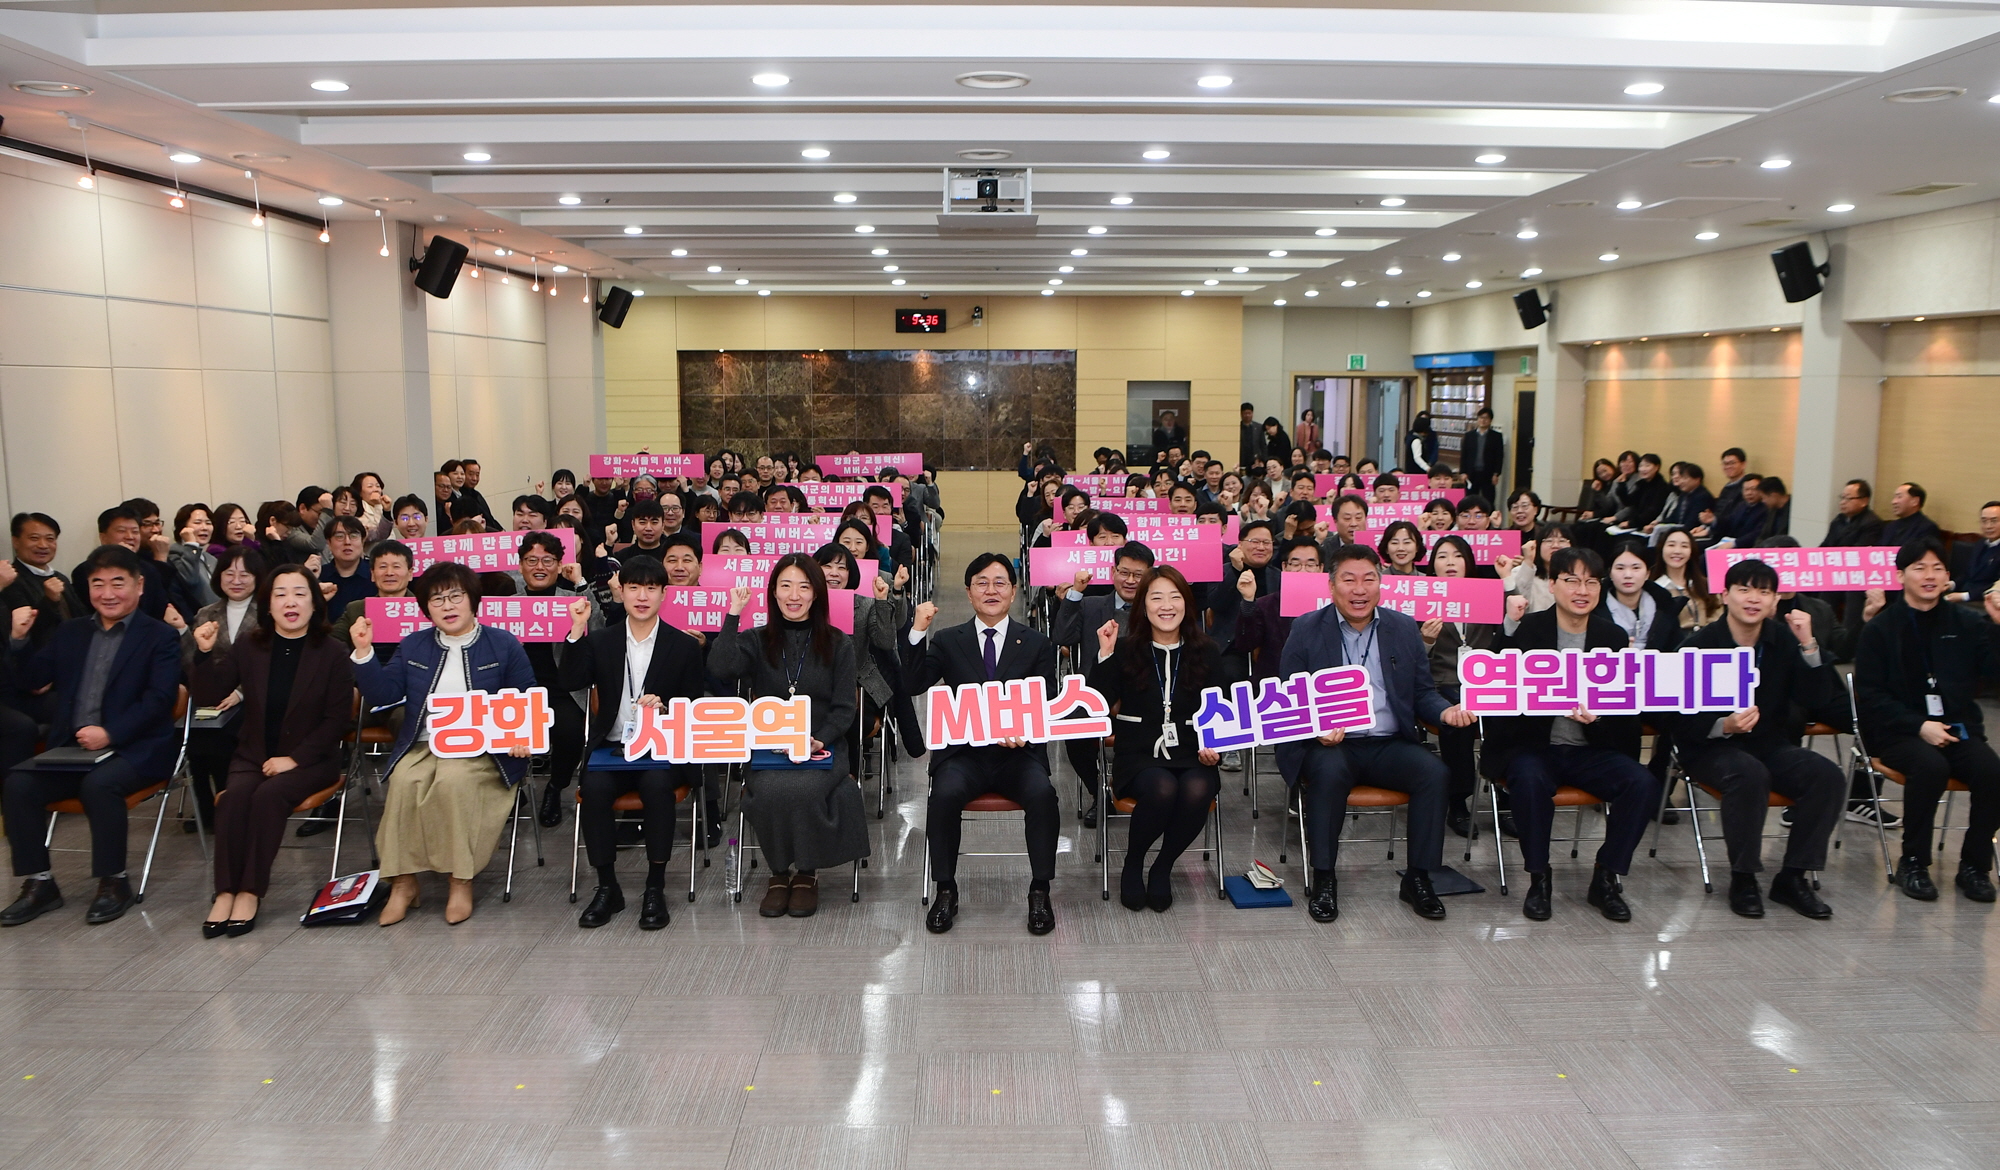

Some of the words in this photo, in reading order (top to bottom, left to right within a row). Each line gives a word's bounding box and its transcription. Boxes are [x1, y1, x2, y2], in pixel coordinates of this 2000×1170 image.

[604, 456, 658, 466] 강화~서울역
[664, 456, 692, 465] M버스
[834, 456, 860, 465] 강화군
[865, 455, 904, 464] 교통혁신!
[844, 466, 870, 474] M버스
[1137, 516, 1160, 527] 함께
[1168, 517, 1196, 526] 만들
[774, 527, 815, 539] M버스
[1172, 528, 1199, 540] 신설
[405, 542, 434, 555] 모두
[443, 538, 473, 553] 함께
[750, 542, 825, 554] 응원합니다
[1067, 550, 1114, 564] 서울까
[1808, 552, 1860, 567] 미래를
[724, 558, 778, 572] 서울까
[1832, 570, 1891, 585] M버스!
[673, 591, 732, 607] 서울까
[385, 602, 425, 618] 강화
[532, 601, 568, 617] 여는
[1426, 602, 1470, 618] 기원!
[1462, 652, 1754, 710] 염원합니다
[931, 679, 1107, 745] M버스
[1198, 670, 1372, 748] 신설을
[432, 692, 550, 753] 강화
[630, 699, 806, 759] 서울역
